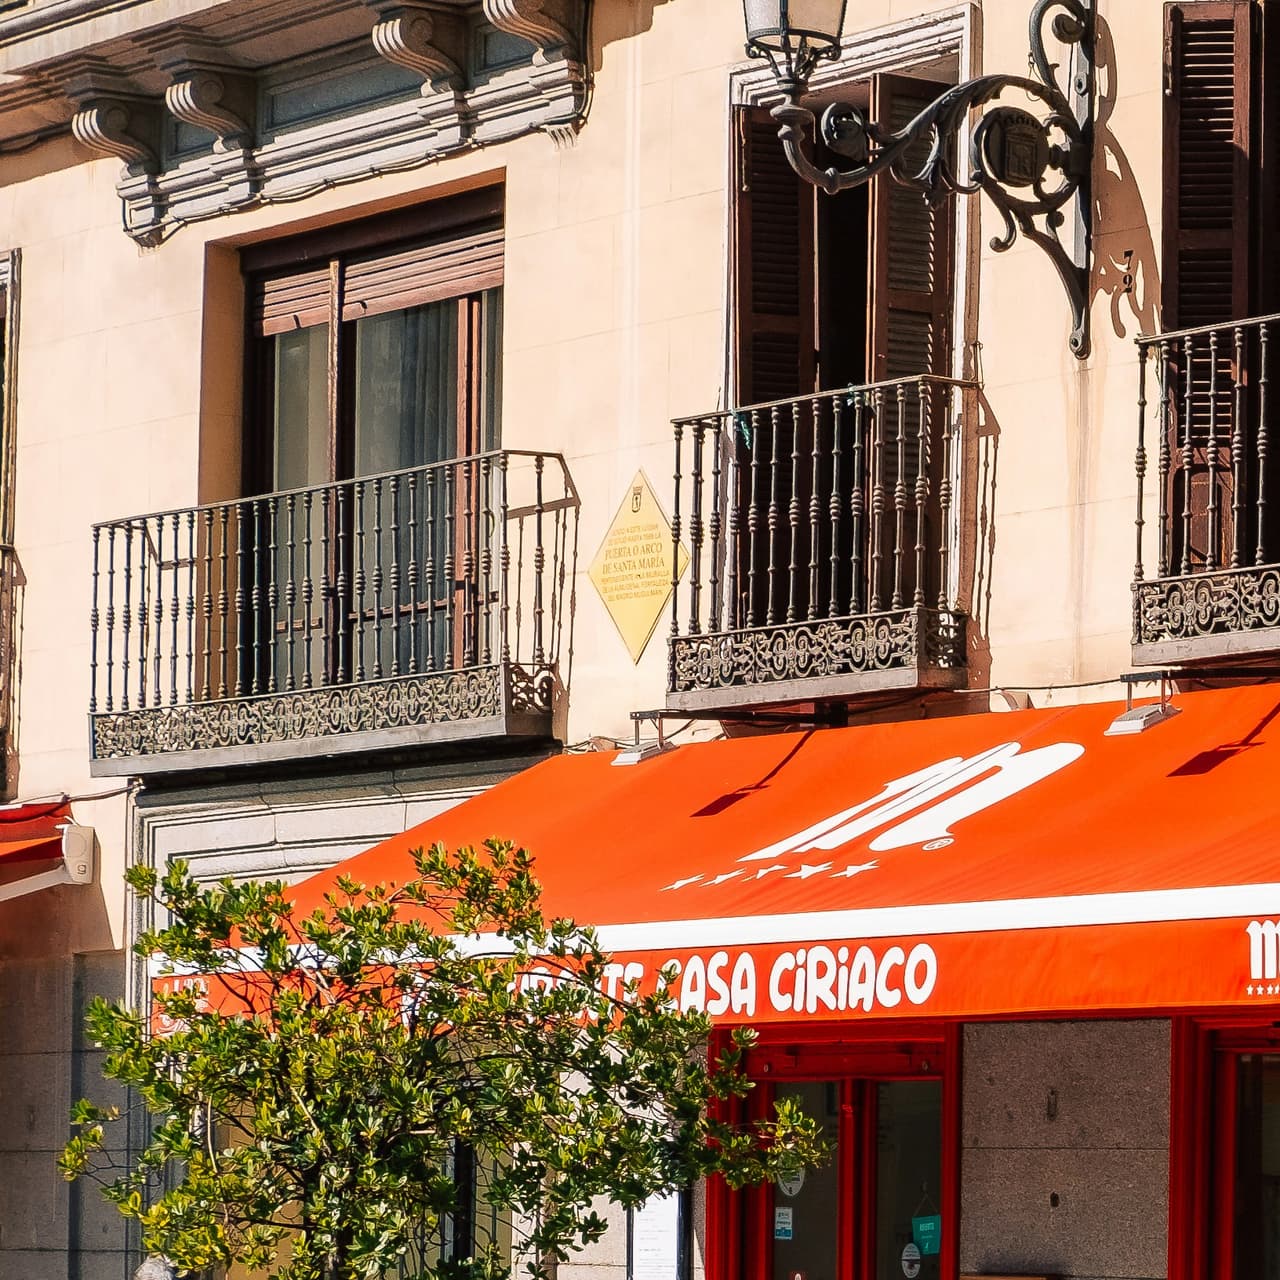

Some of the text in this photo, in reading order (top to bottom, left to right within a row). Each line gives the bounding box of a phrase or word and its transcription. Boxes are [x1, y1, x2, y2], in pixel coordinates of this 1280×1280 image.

[605, 542, 663, 561] PUERTA O ARCO
[602, 562, 612, 575] DE
[613, 560, 637, 573] SANTA
